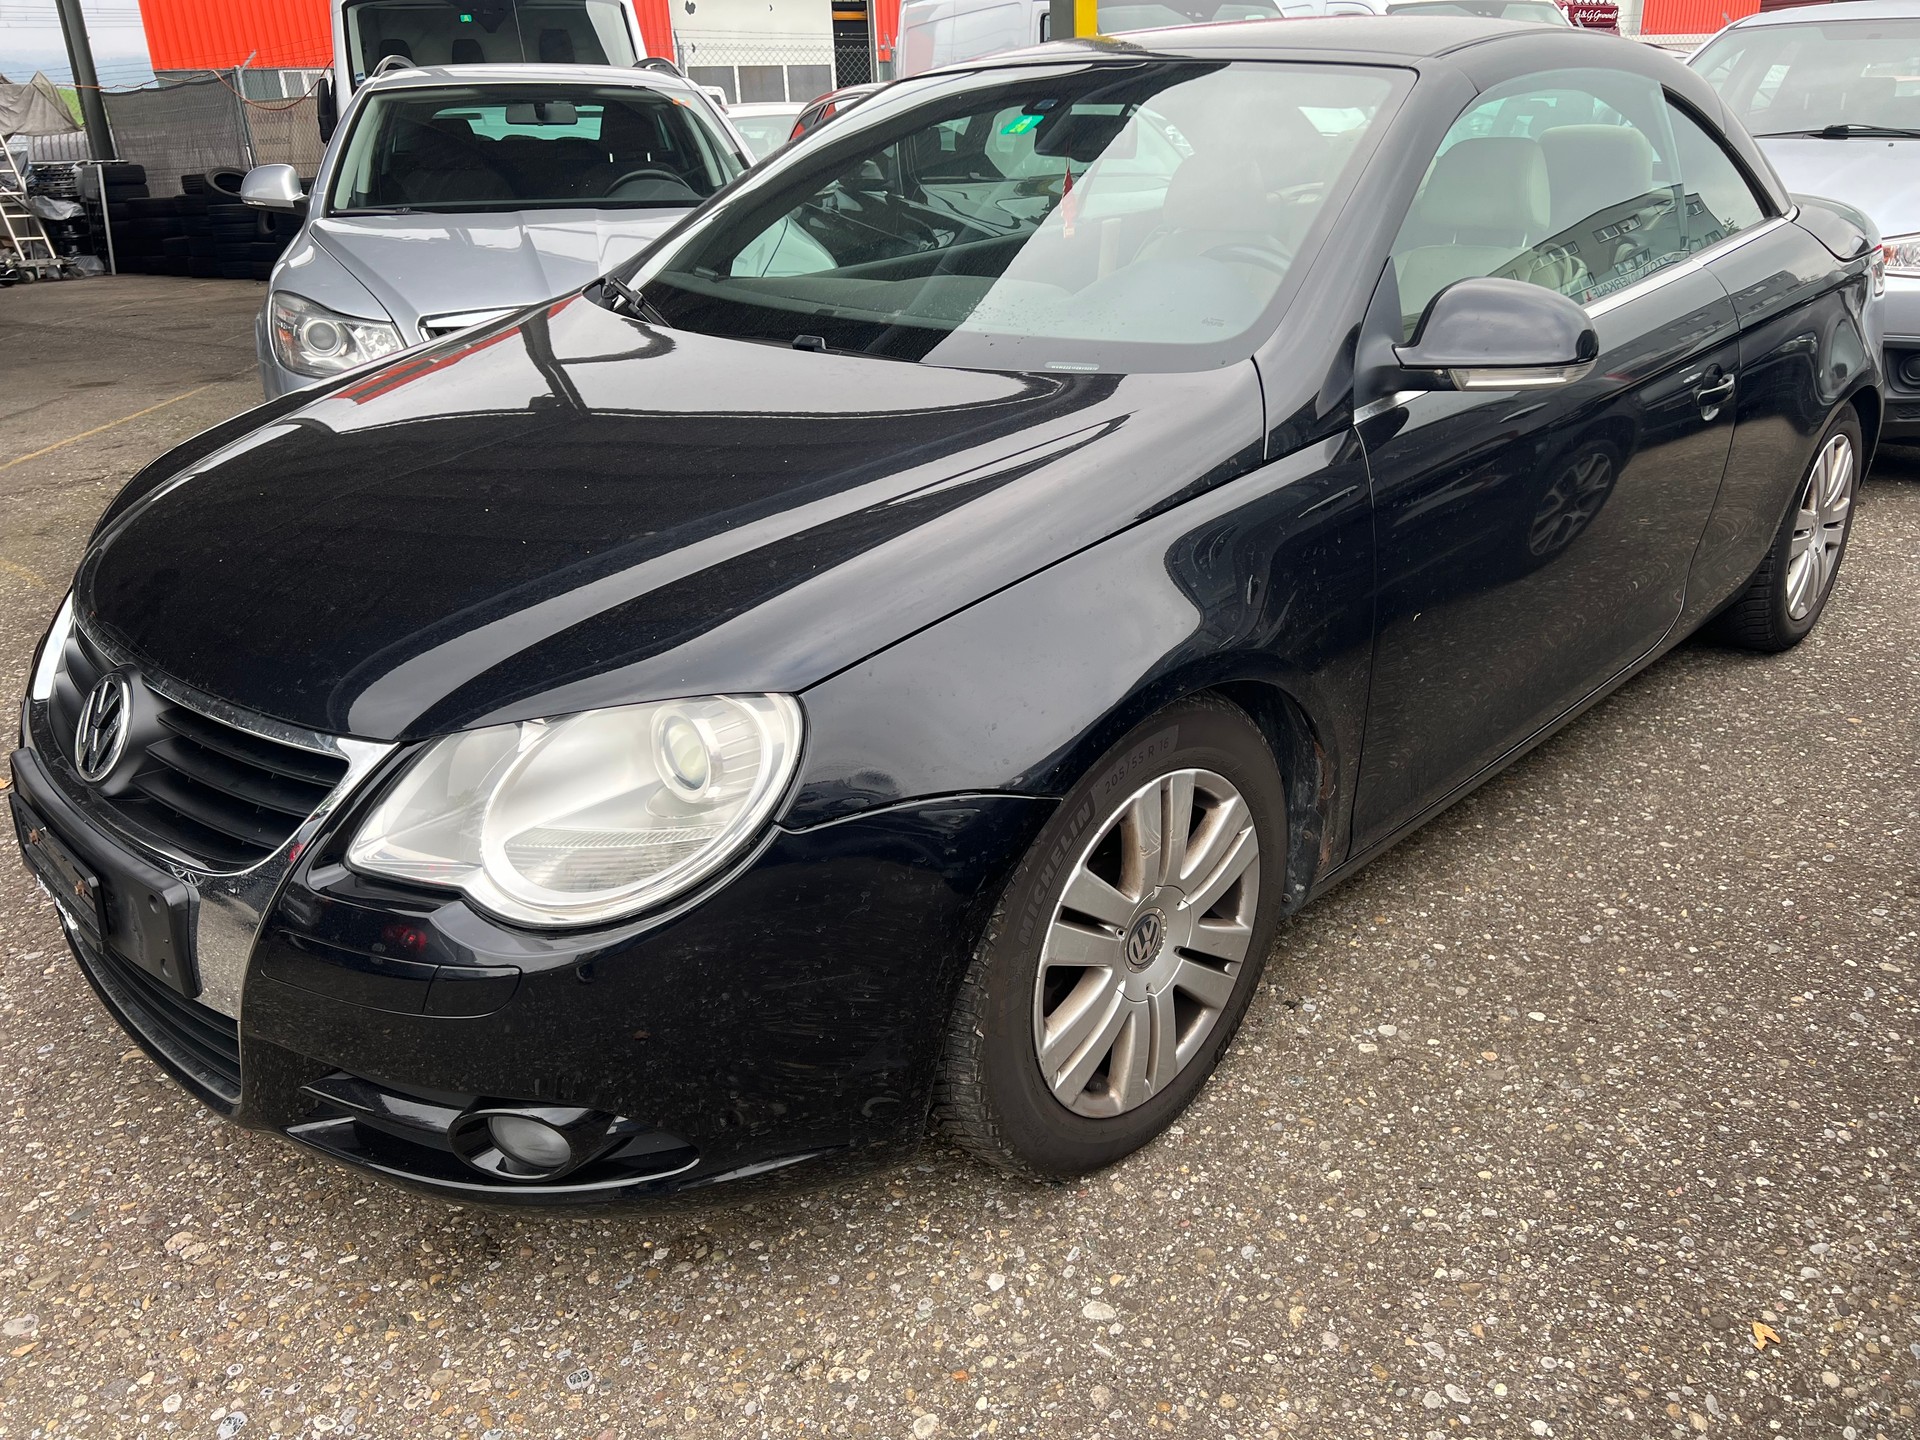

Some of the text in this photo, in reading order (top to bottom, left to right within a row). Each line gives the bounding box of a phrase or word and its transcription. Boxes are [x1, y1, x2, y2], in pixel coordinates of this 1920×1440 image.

[1103, 754, 1144, 795] 205/55
[1159, 737, 1170, 751] 16
[1017, 801, 1093, 946] MICHELIN
